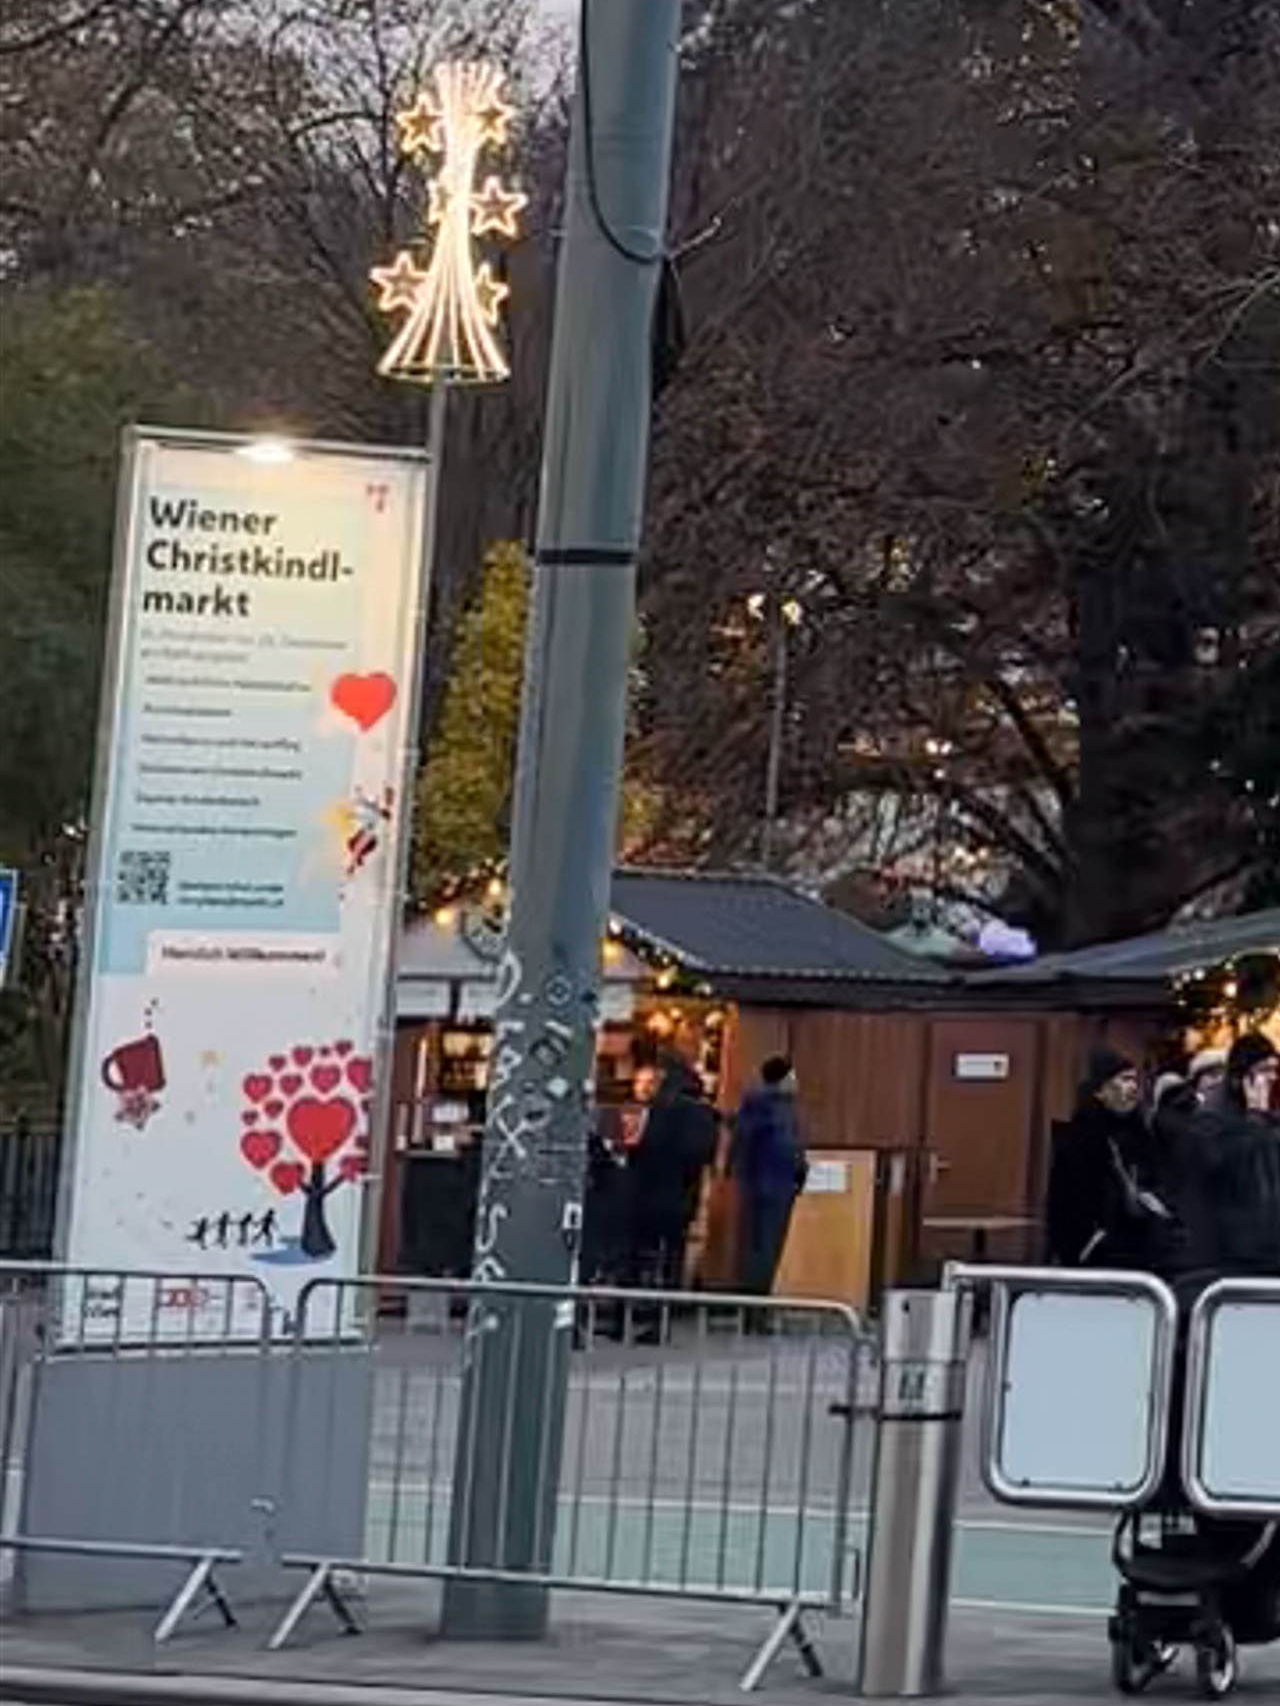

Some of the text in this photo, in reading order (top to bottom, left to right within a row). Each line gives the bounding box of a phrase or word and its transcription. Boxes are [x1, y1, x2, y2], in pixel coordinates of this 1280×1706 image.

[149, 495, 277, 536] Wiener
[146, 538, 355, 582] Christkindl-
[143, 582, 250, 617] markt
